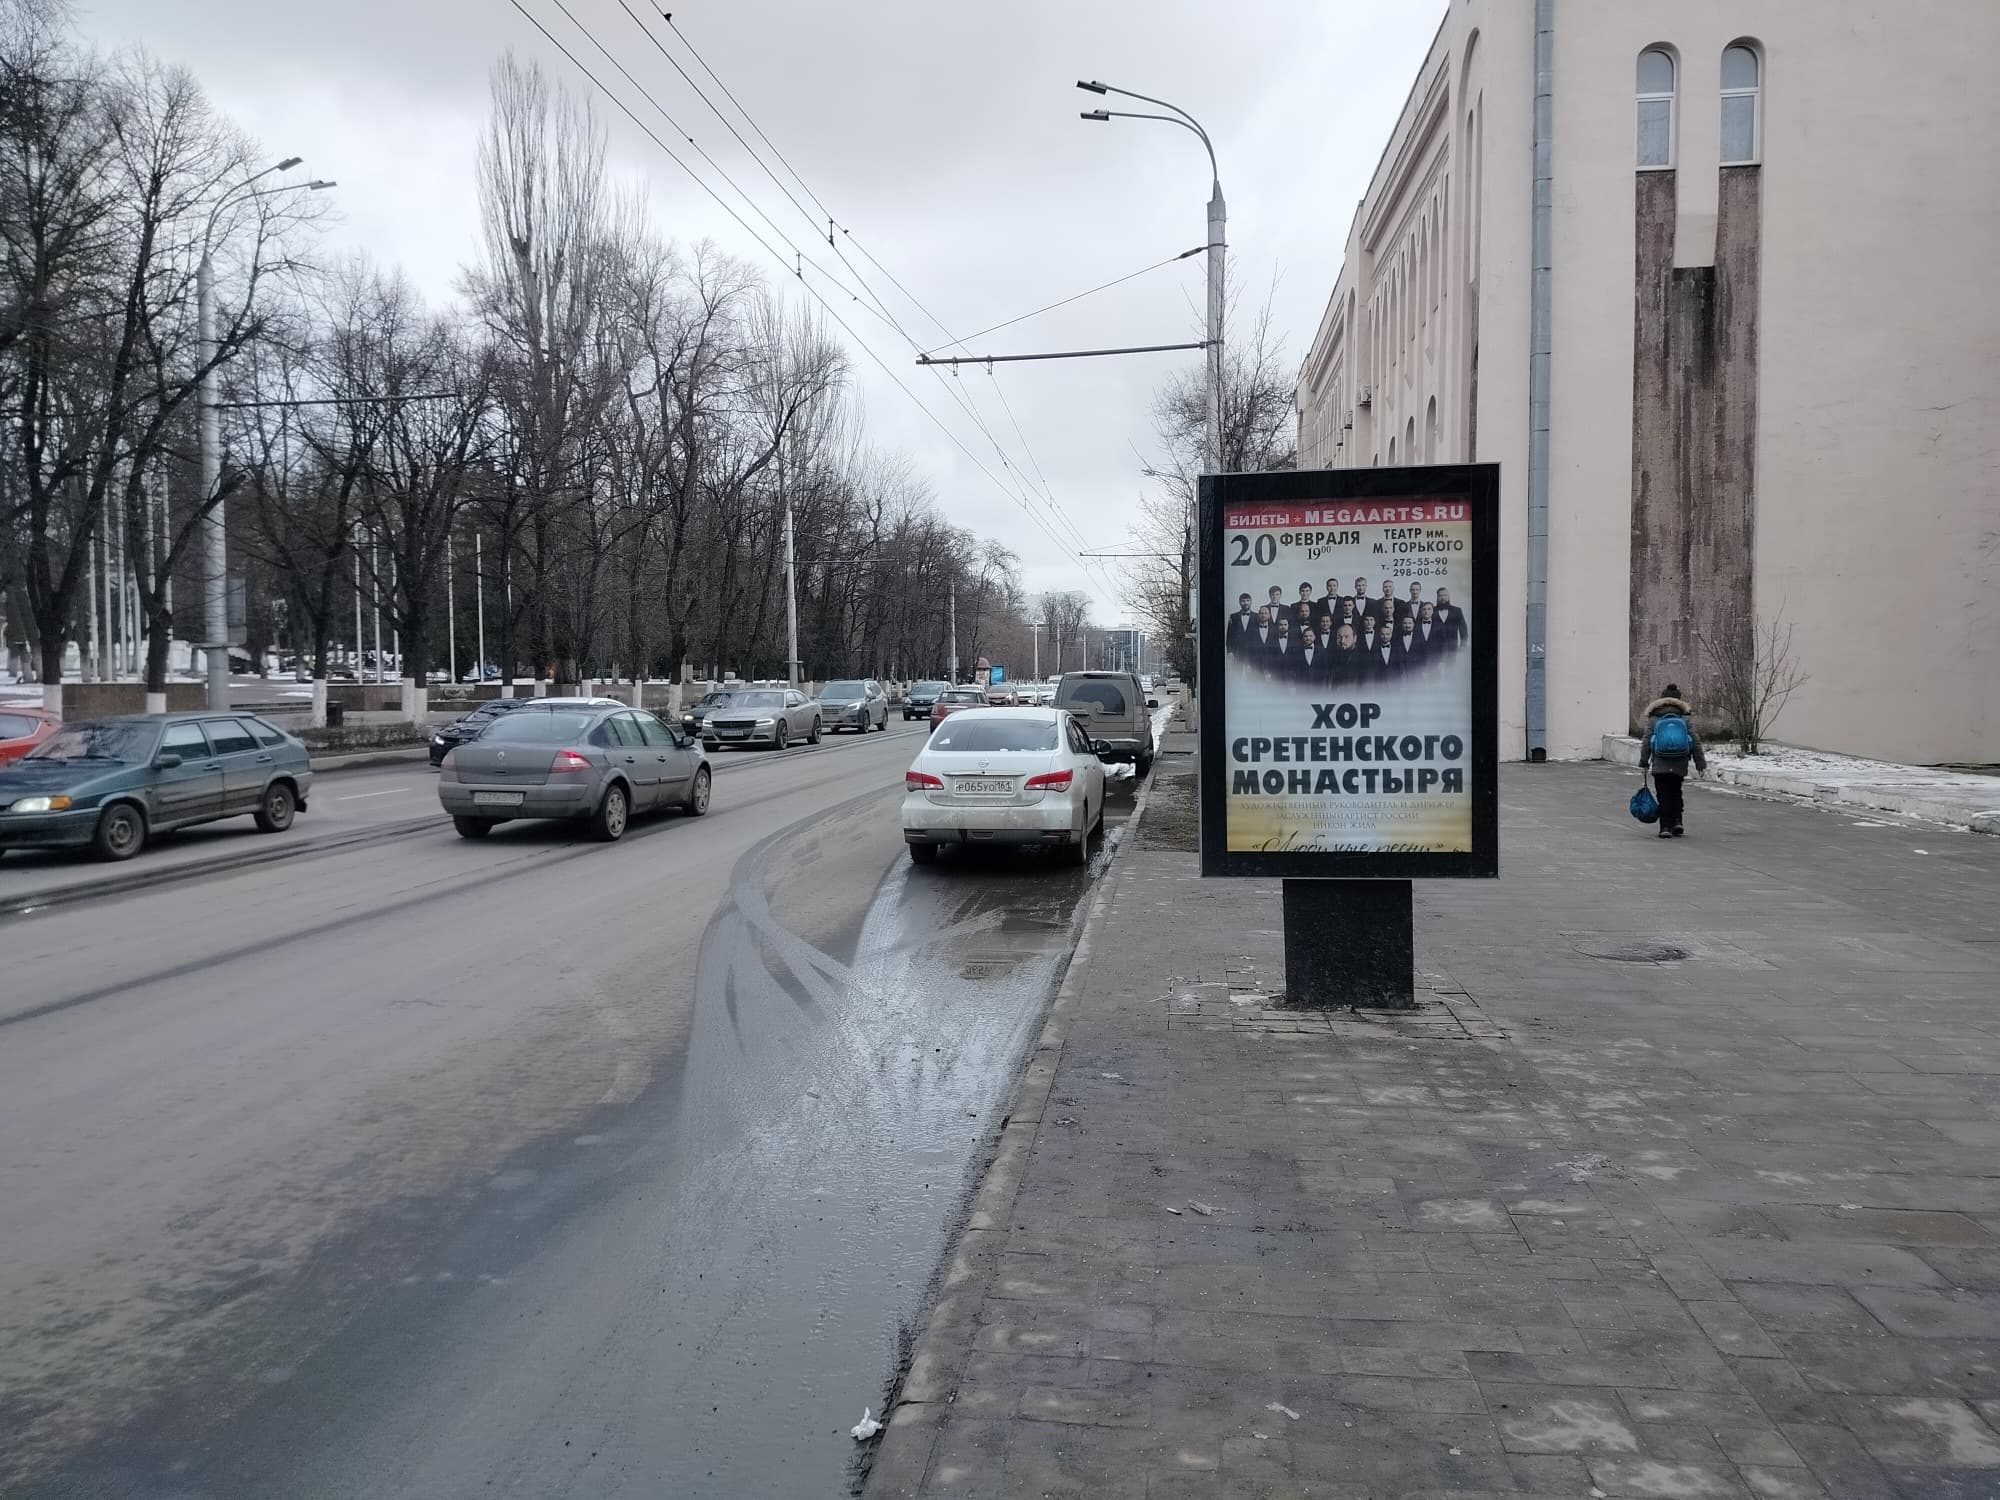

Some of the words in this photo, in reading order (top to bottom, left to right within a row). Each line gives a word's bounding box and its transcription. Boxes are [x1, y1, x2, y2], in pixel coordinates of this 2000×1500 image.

[1229, 513, 1290, 527] БИЛЕТЫ
[1304, 505, 1464, 524] MEGAARTS.RU
[1384, 528, 1422, 540] ТЕАТР
[1426, 530, 1449, 539] им.
[1230, 533, 1277, 567] 20
[1279, 531, 1360, 547] ФЕВРАЛЯ
[1372, 543, 1388, 554] М.
[1392, 540, 1464, 554] ГОРЬКОГО
[1392, 557, 1448, 567] 275-55-90
[1392, 567, 1448, 577] 298-00-66
[1311, 703, 1381, 730] ХОР
[1232, 734, 1464, 763] СРЕТЕНСКОГО
[1232, 767, 1464, 795] МОНАСТЫРЯ
